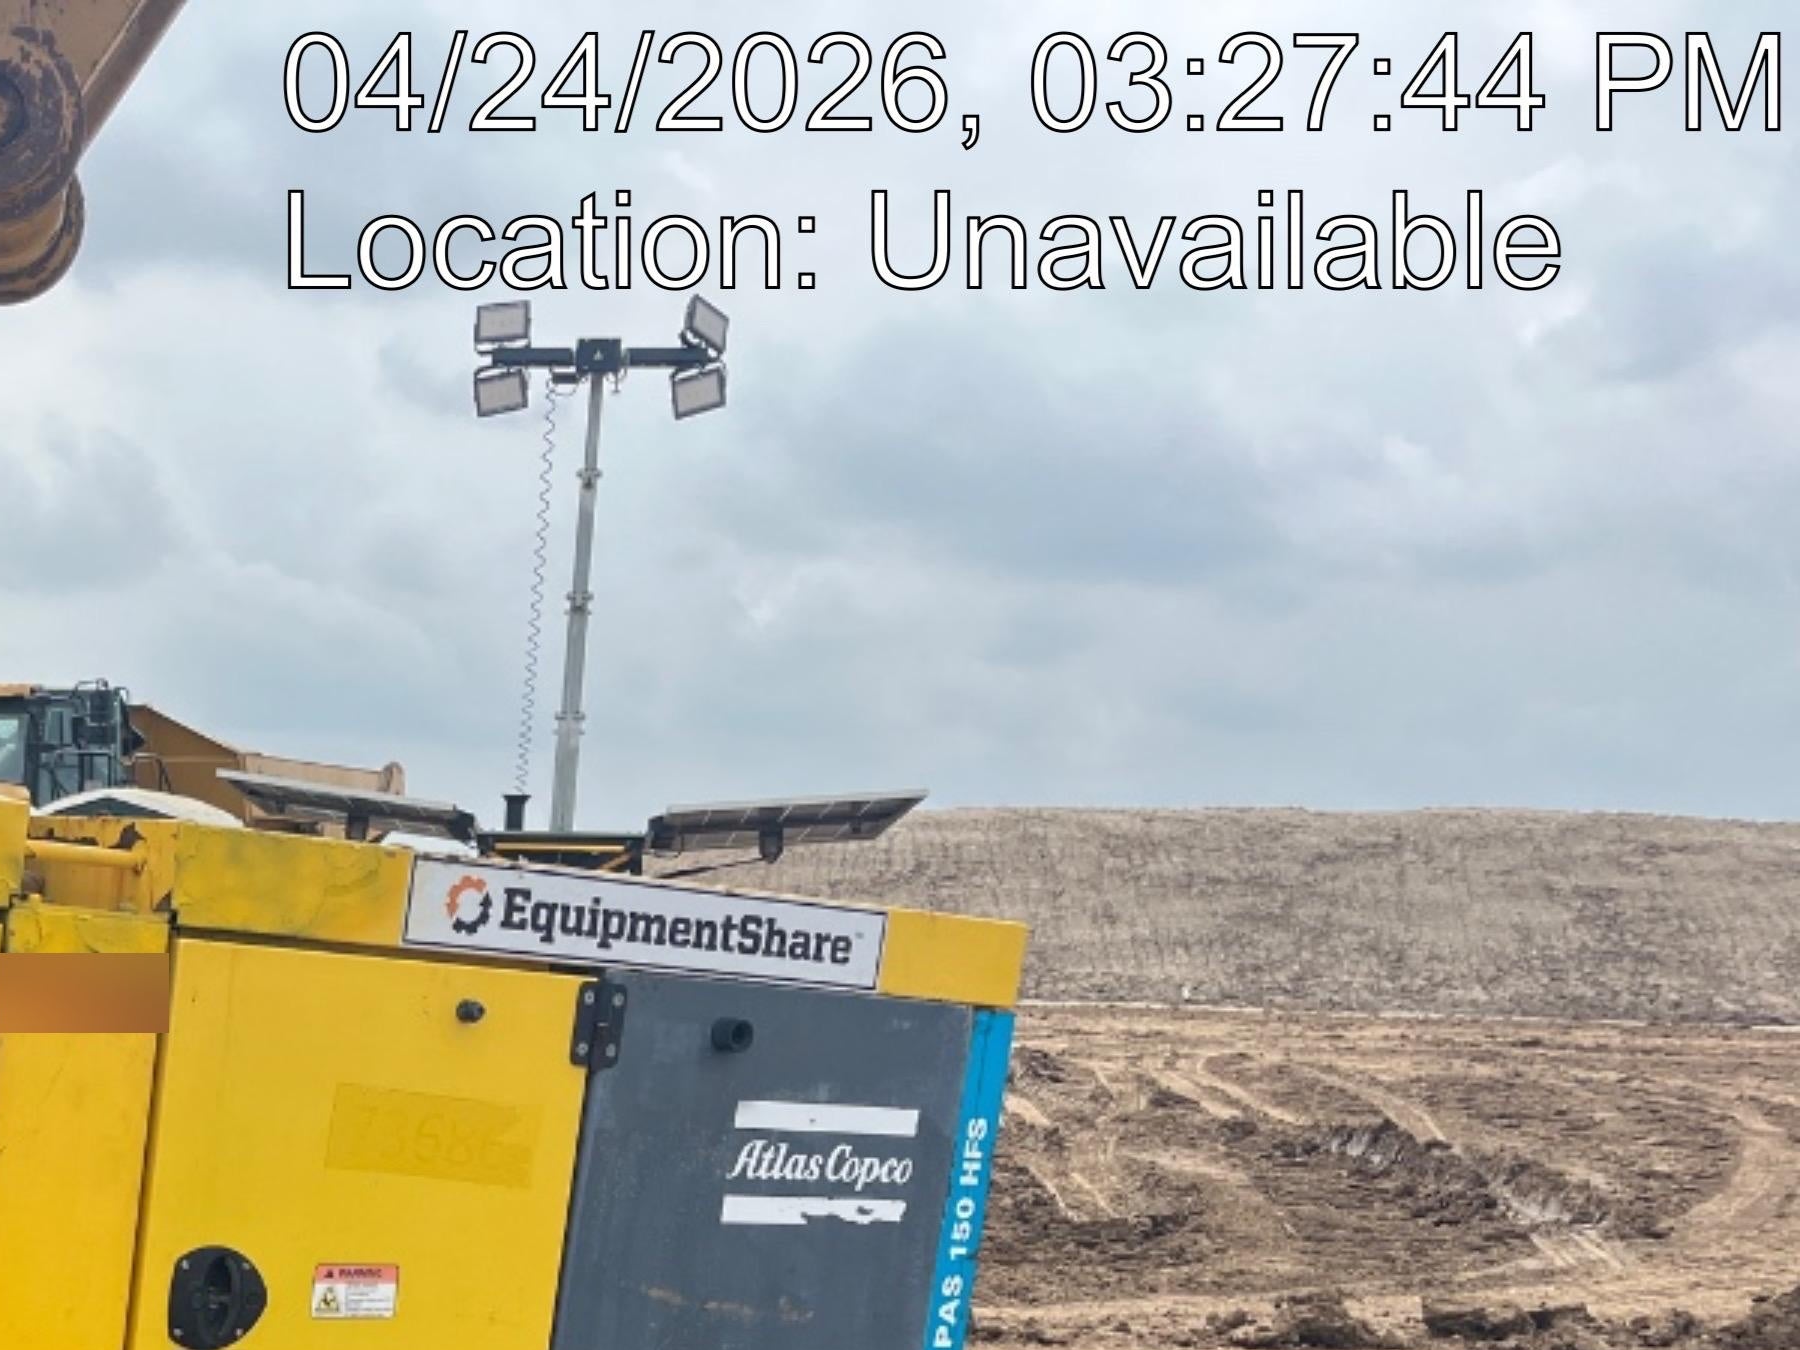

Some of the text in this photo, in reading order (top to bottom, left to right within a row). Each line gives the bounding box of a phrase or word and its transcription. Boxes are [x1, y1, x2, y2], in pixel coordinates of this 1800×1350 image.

[501, 887, 853, 965] EquipmentShare
[725, 1139, 913, 1192] Atlas Copco
[932, 1118, 988, 1349] PAS 150 HFS
